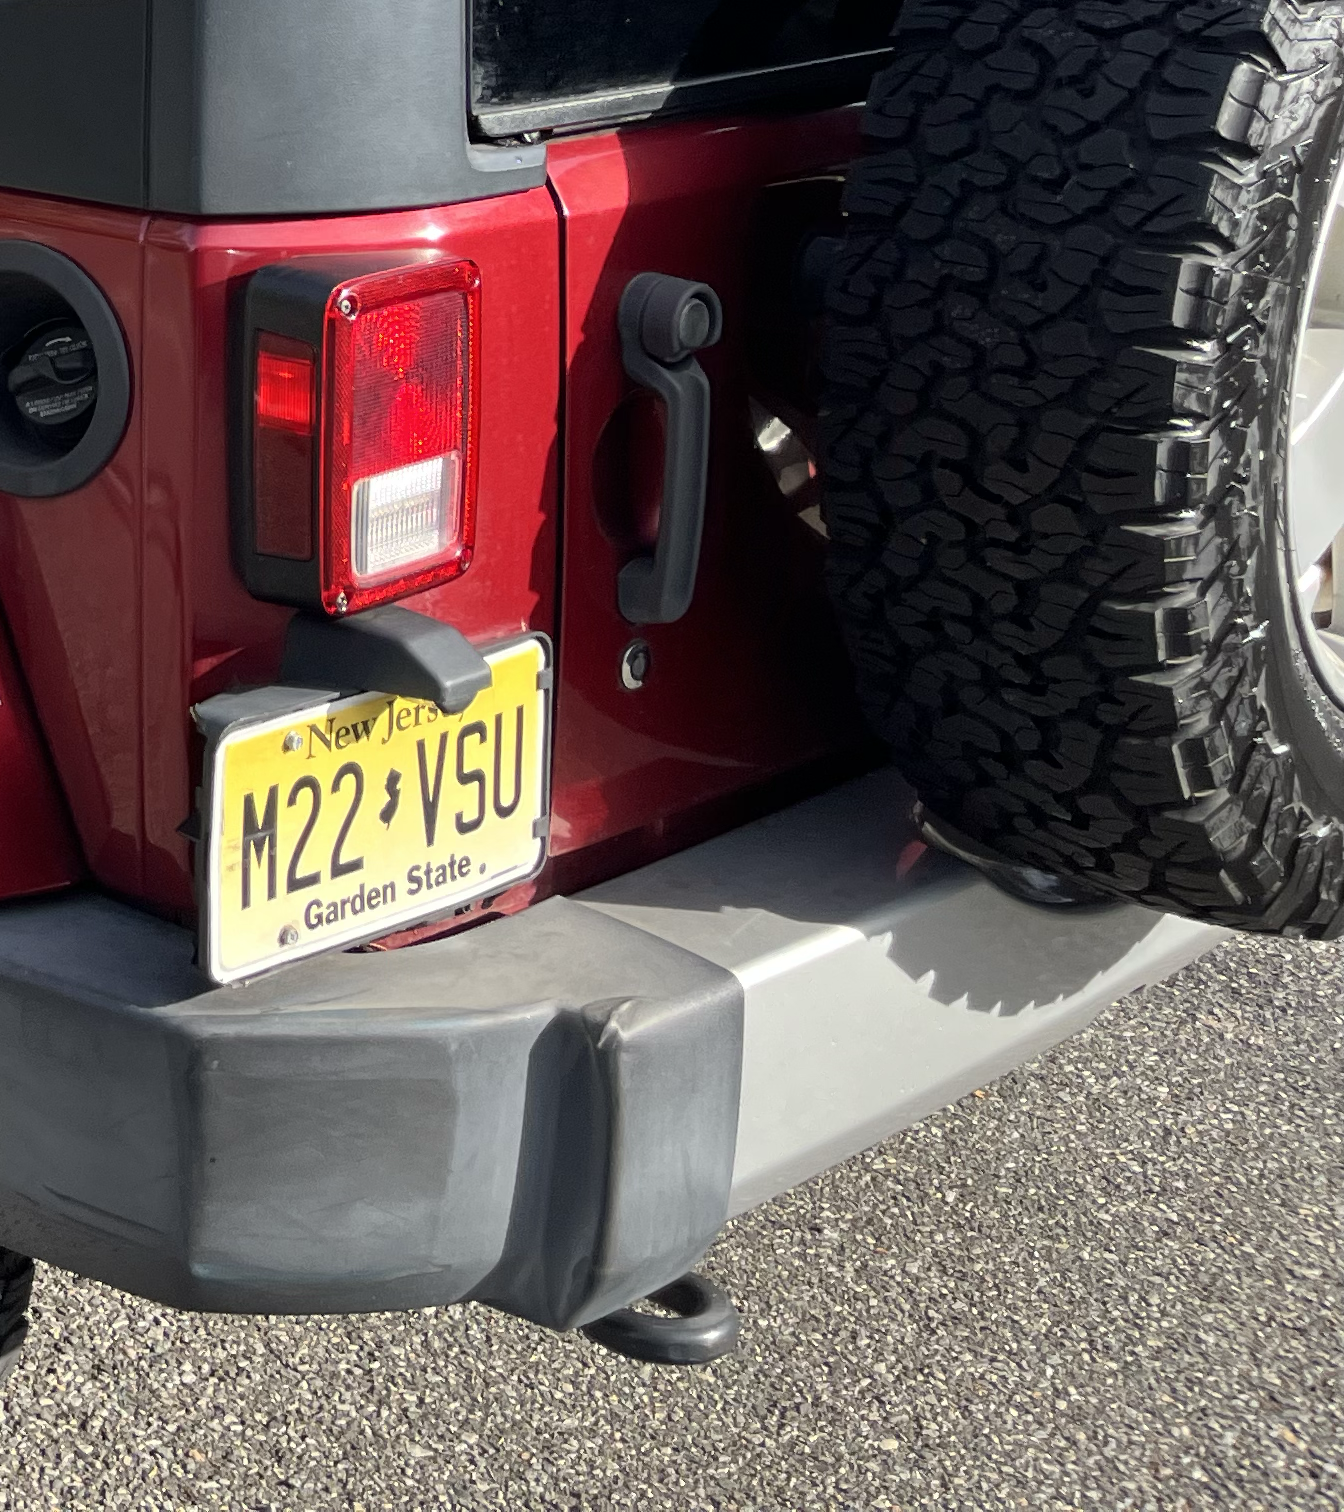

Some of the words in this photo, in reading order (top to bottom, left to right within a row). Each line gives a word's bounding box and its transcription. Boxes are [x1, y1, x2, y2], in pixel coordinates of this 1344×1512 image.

[306, 717, 375, 760] New
[381, 696, 464, 745] Jers
[240, 761, 365, 911] M22
[416, 704, 525, 848] VSU
[303, 880, 397, 931] Garden
[406, 853, 472, 896] State
